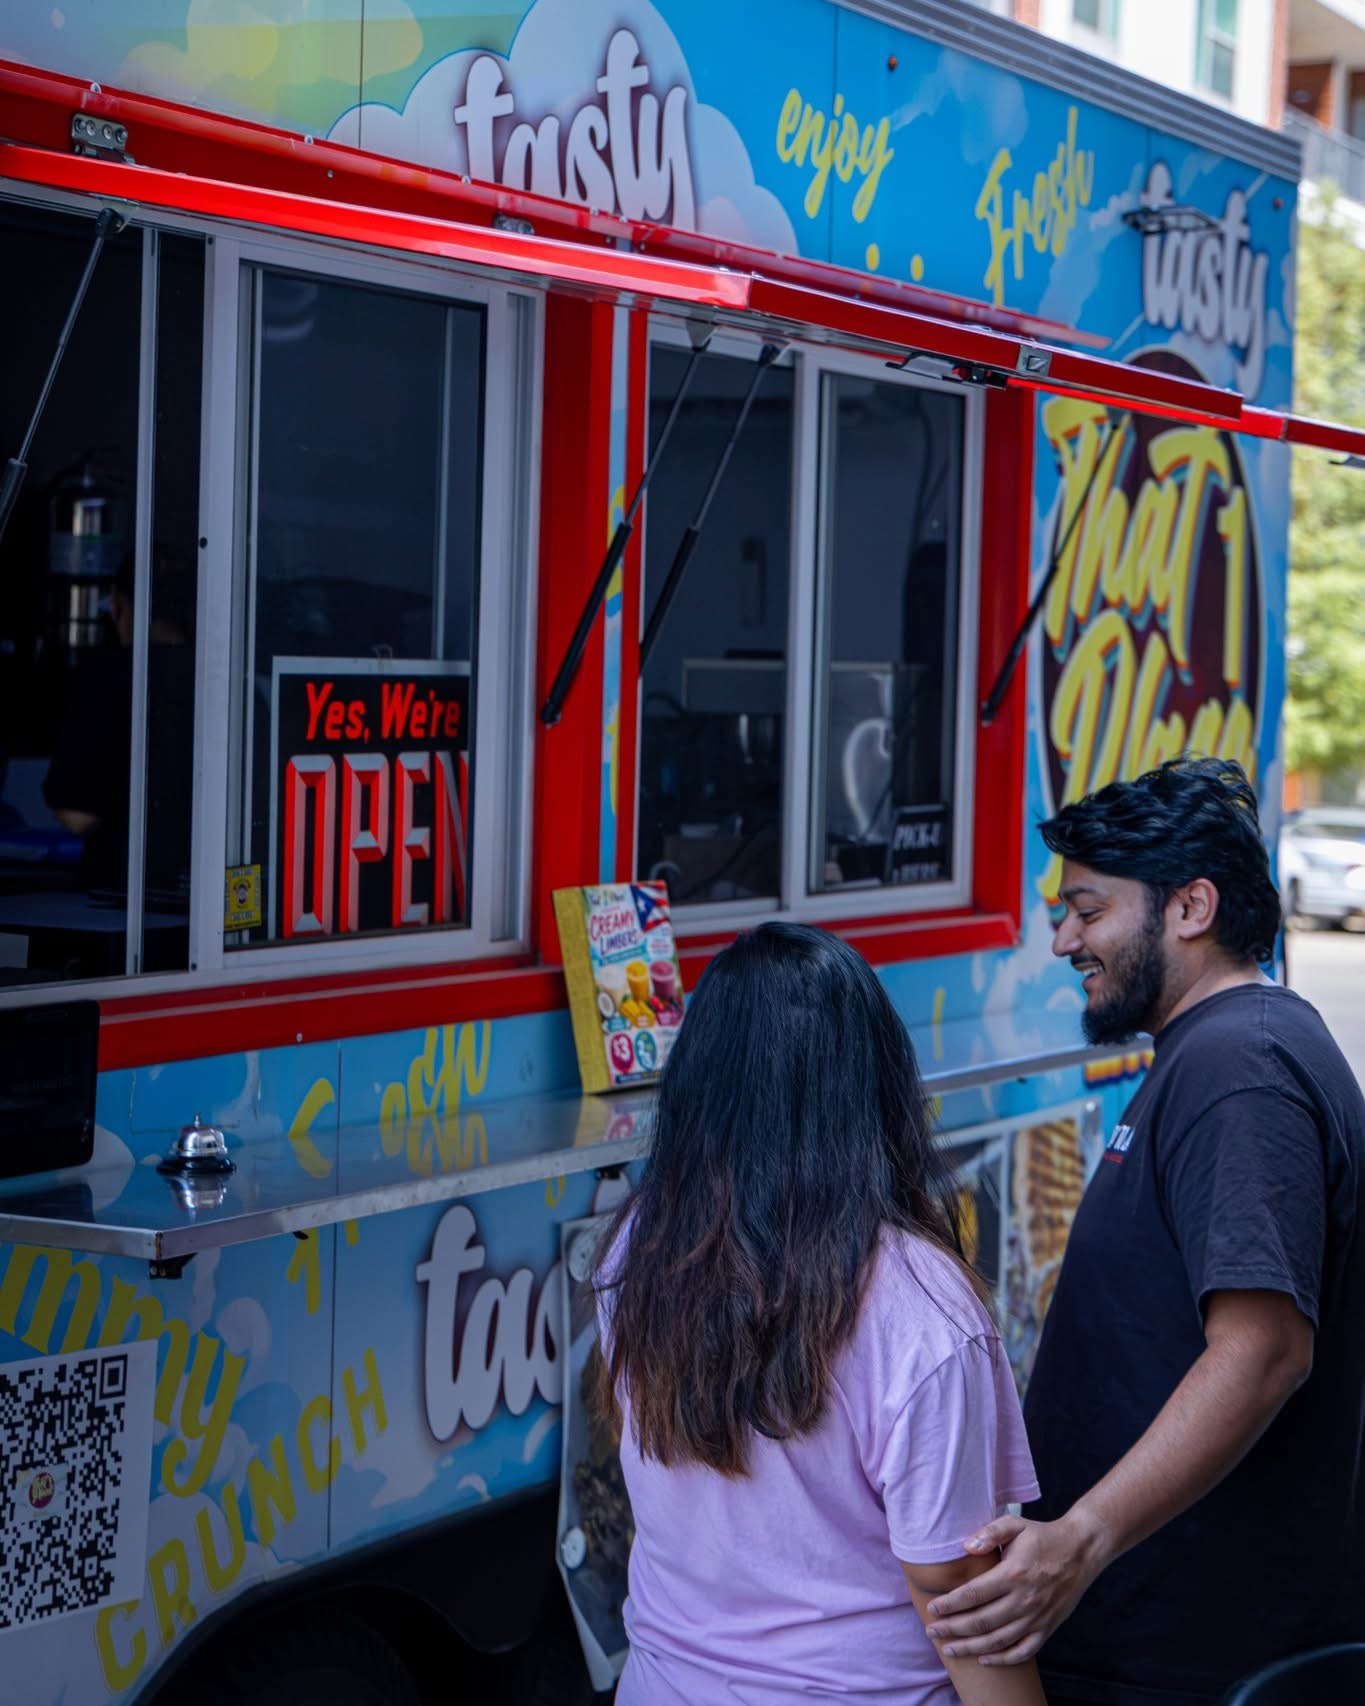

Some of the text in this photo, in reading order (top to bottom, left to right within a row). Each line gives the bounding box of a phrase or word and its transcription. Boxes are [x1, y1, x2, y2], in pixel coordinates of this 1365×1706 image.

[776, 88, 895, 224] enjoy
[975, 106, 1095, 308] Fresh
[305, 682, 461, 743] Yes, We're
[283, 750, 469, 939] OPEN
[590, 907, 635, 941] CREAMY
[600, 927, 640, 956] LIMBERS
[95, 1346, 388, 1693] CRUNCH
